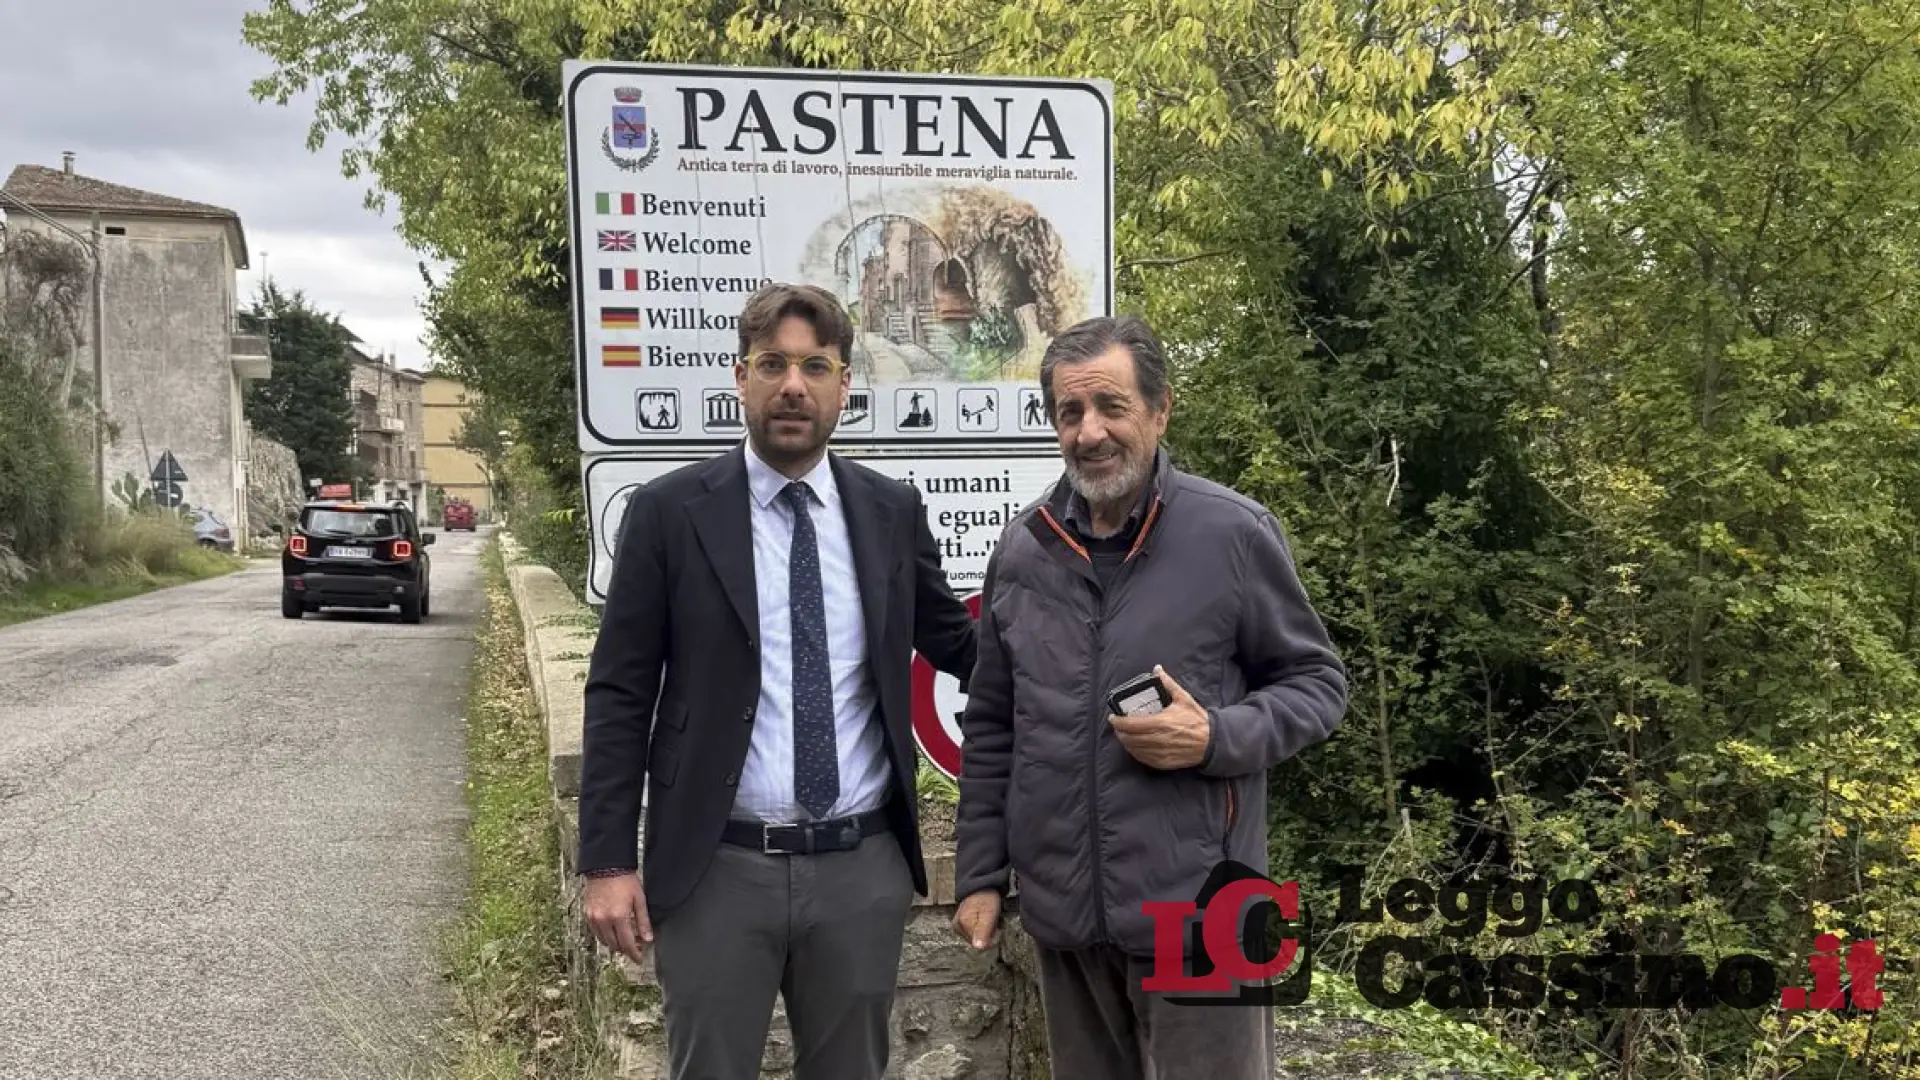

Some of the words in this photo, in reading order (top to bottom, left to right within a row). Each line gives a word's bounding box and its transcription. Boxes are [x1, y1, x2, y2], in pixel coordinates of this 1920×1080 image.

[677, 87, 1075, 160] PASTENA
[677, 157, 727, 172] Antica
[731, 160, 769, 174] terra
[773, 160, 787, 174] di
[791, 161, 842, 178] lavoro,
[847, 162, 932, 177] inesauribile
[936, 164, 1011, 181] meraviglia
[1015, 167, 1078, 181] naturale.
[641, 193, 766, 217] Benvenuti
[642, 231, 752, 255] Welcome
[925, 469, 1012, 494] umani
